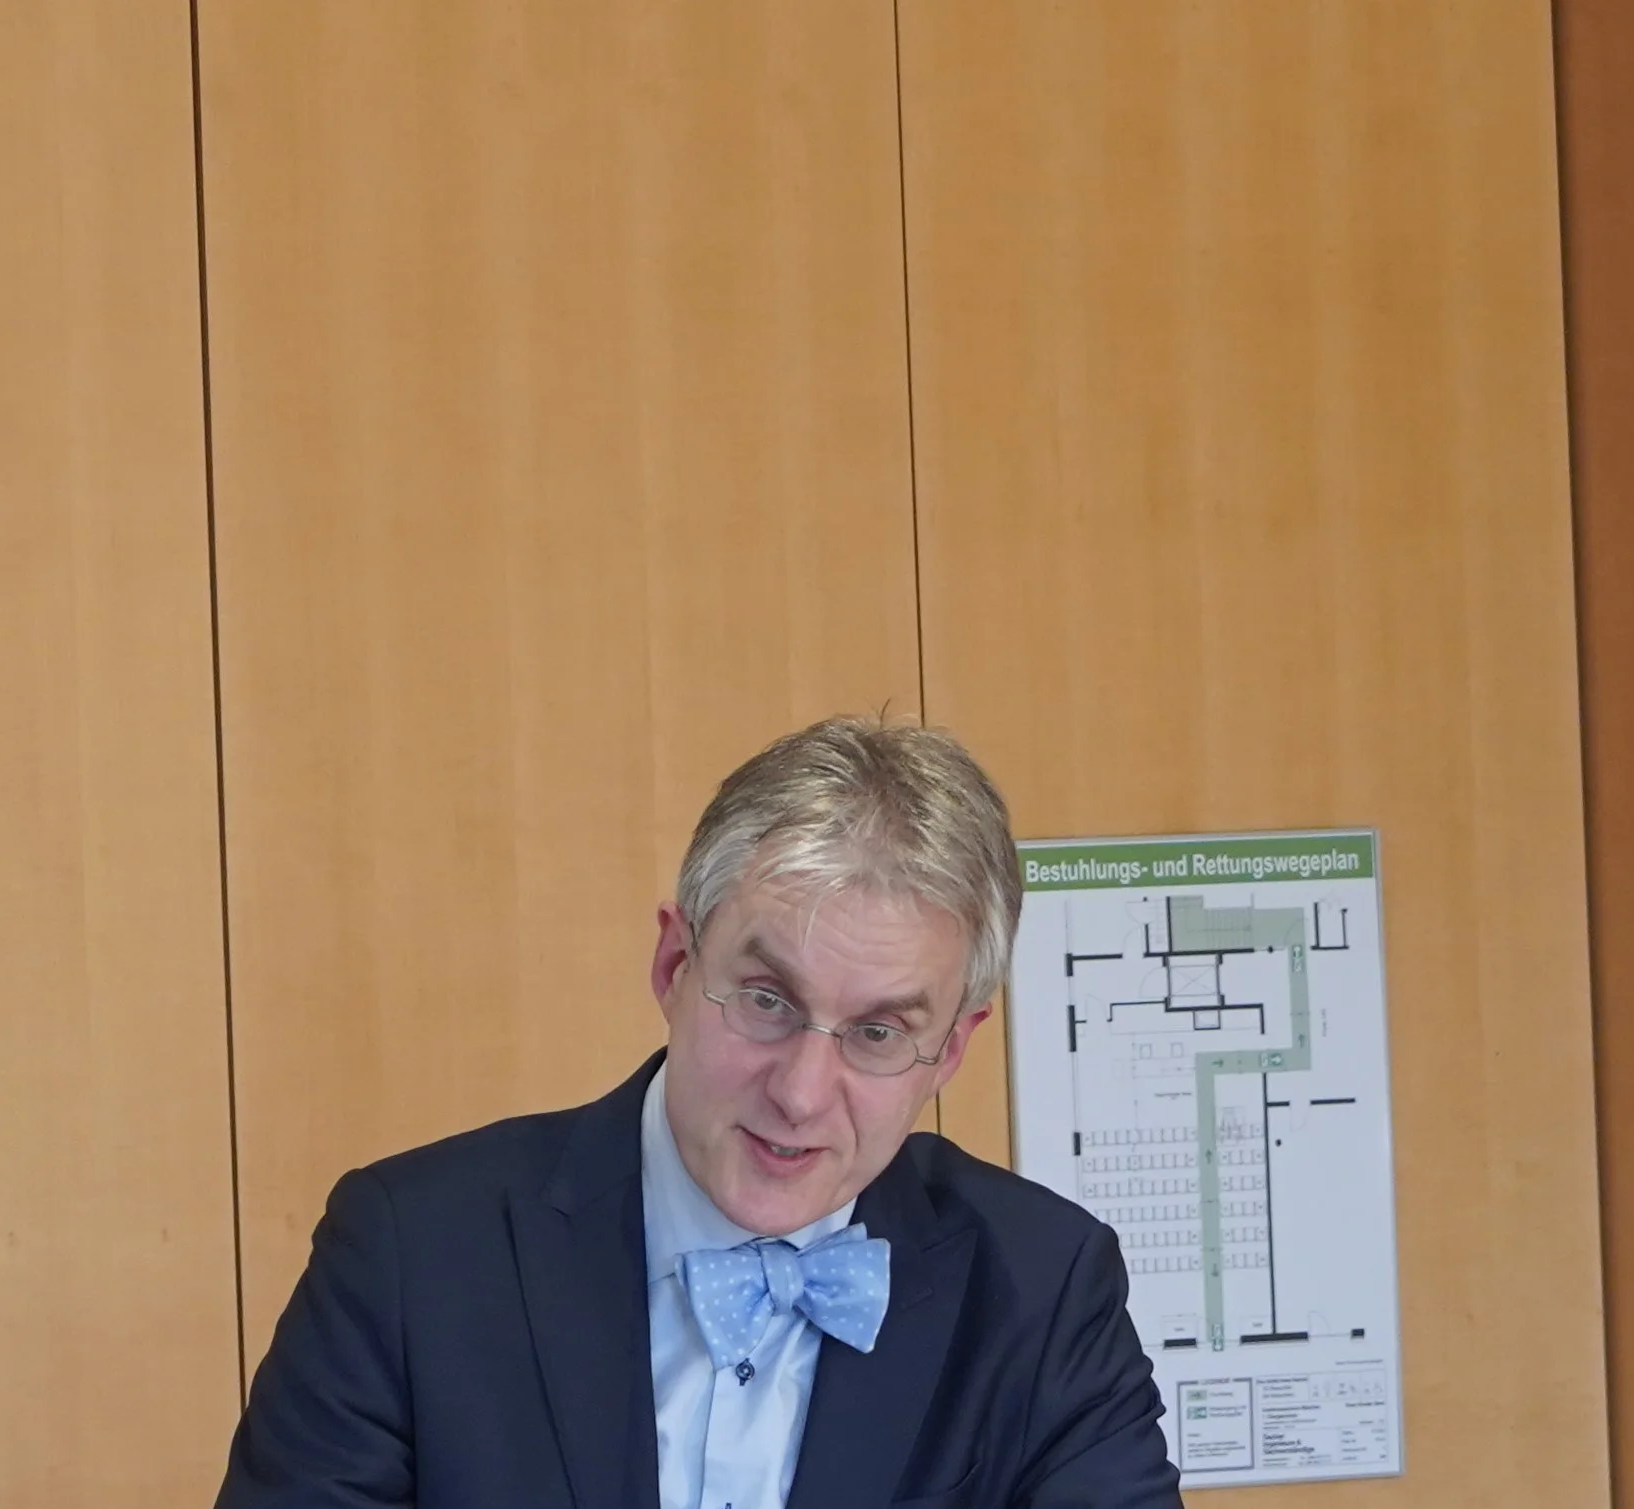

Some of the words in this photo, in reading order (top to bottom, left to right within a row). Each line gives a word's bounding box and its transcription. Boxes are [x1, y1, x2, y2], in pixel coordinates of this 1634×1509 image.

[1025, 858, 1148, 885] Bestuhlungs-
[1153, 854, 1188, 878] und
[1193, 848, 1359, 879] Rettungswegeplan
